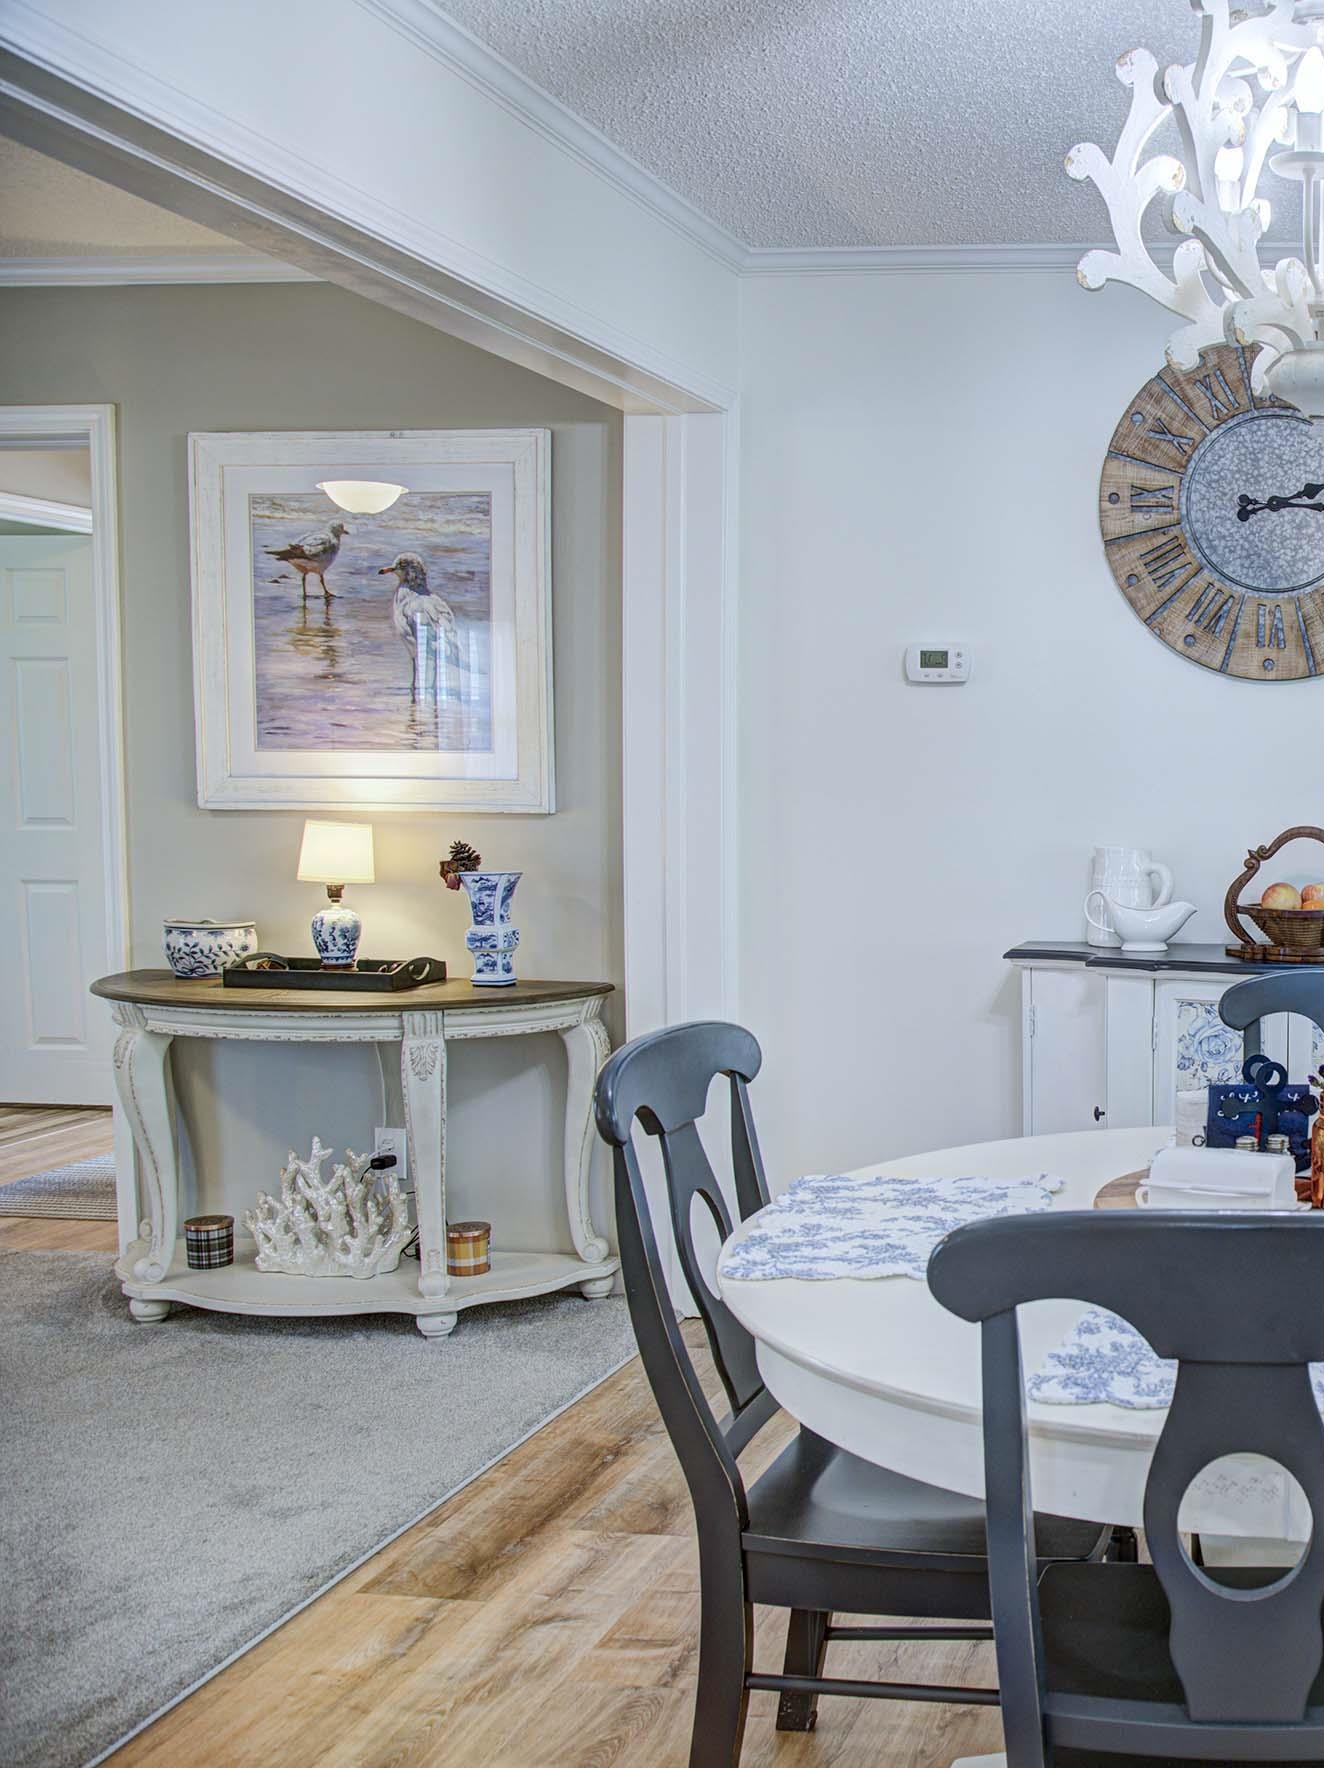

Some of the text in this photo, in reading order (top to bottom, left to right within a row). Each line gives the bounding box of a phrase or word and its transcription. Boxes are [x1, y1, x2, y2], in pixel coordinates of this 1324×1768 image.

[1194, 368, 1240, 420] XI
[1147, 417, 1194, 456] X
[1130, 484, 1174, 513] IX
[1140, 536, 1192, 592] VIII
[1185, 582, 1235, 639] VII
[1256, 603, 1286, 649] VI
